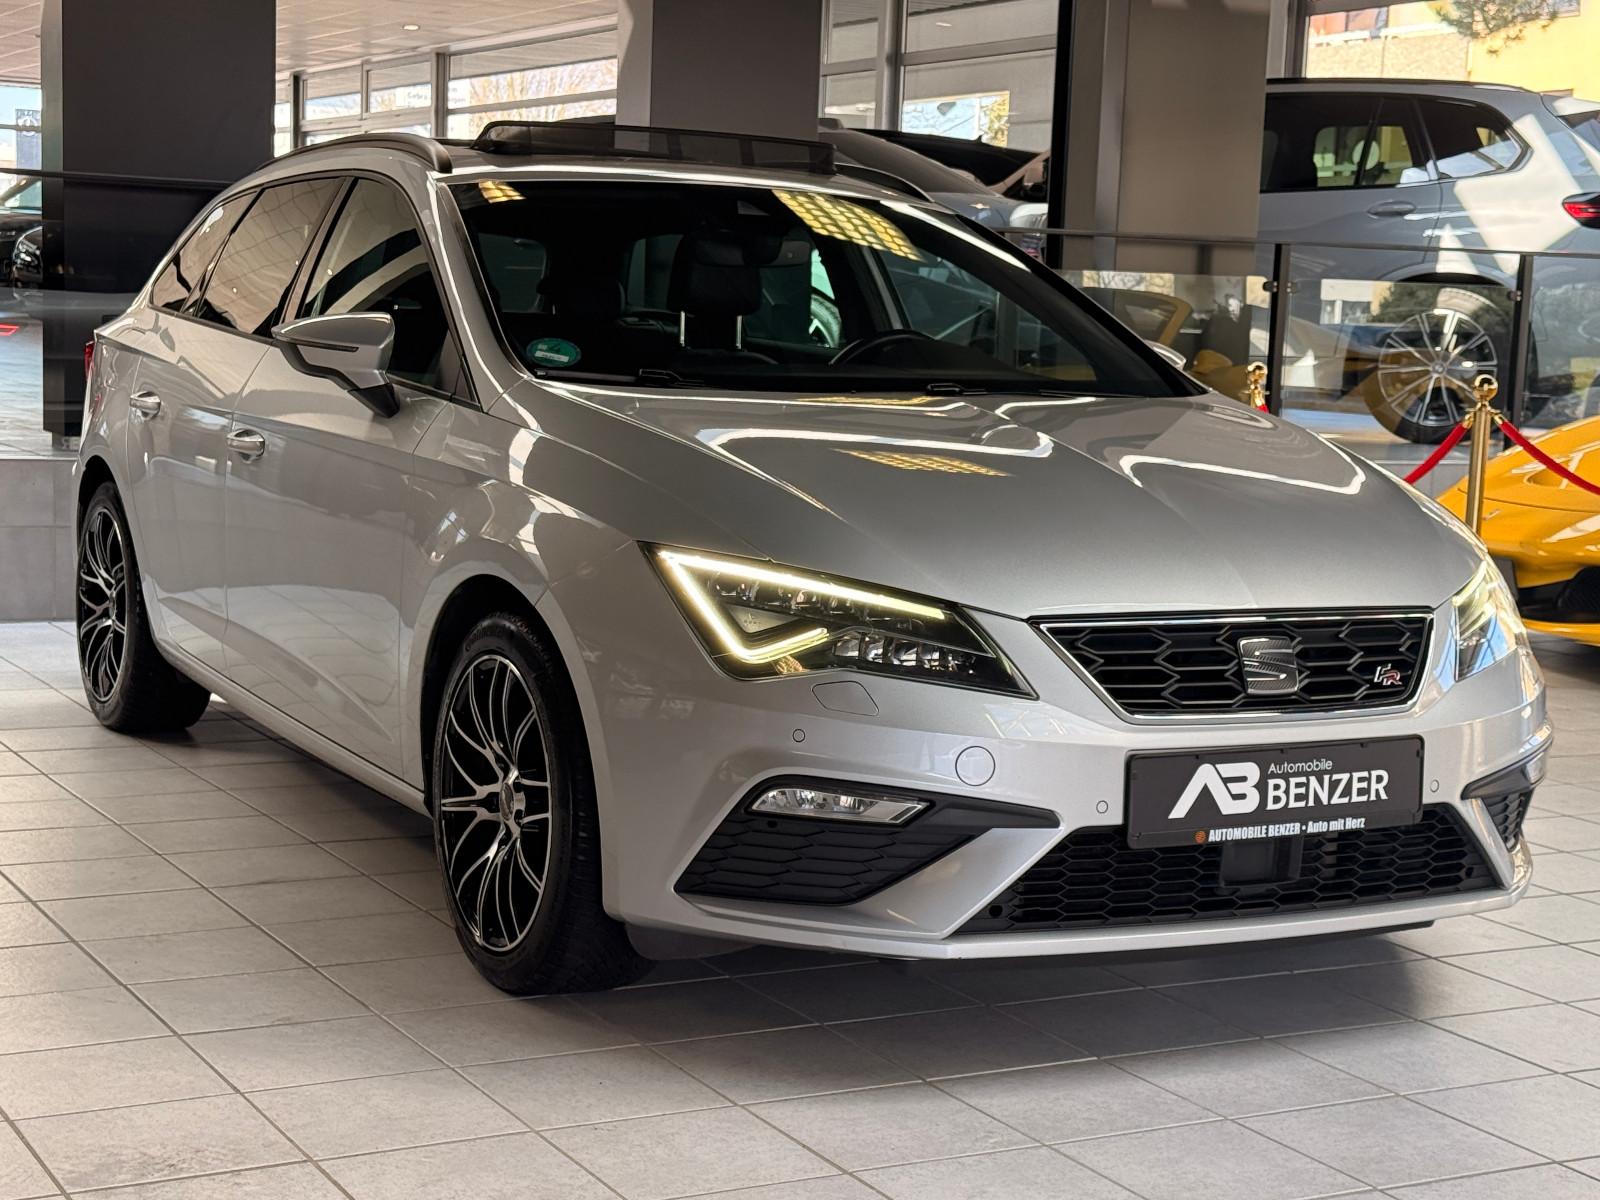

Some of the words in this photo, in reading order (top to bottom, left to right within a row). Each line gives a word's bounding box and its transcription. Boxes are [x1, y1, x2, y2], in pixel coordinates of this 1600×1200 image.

[1268, 758, 1333, 774] Automobile
[1266, 769, 1389, 811] BENZER
[1208, 825, 1267, 843] AUTOMOBILE
[1268, 822, 1301, 838] BENZER
[1307, 821, 1328, 833] Auto
[1329, 818, 1345, 831] mit
[1345, 817, 1366, 830] Herz
